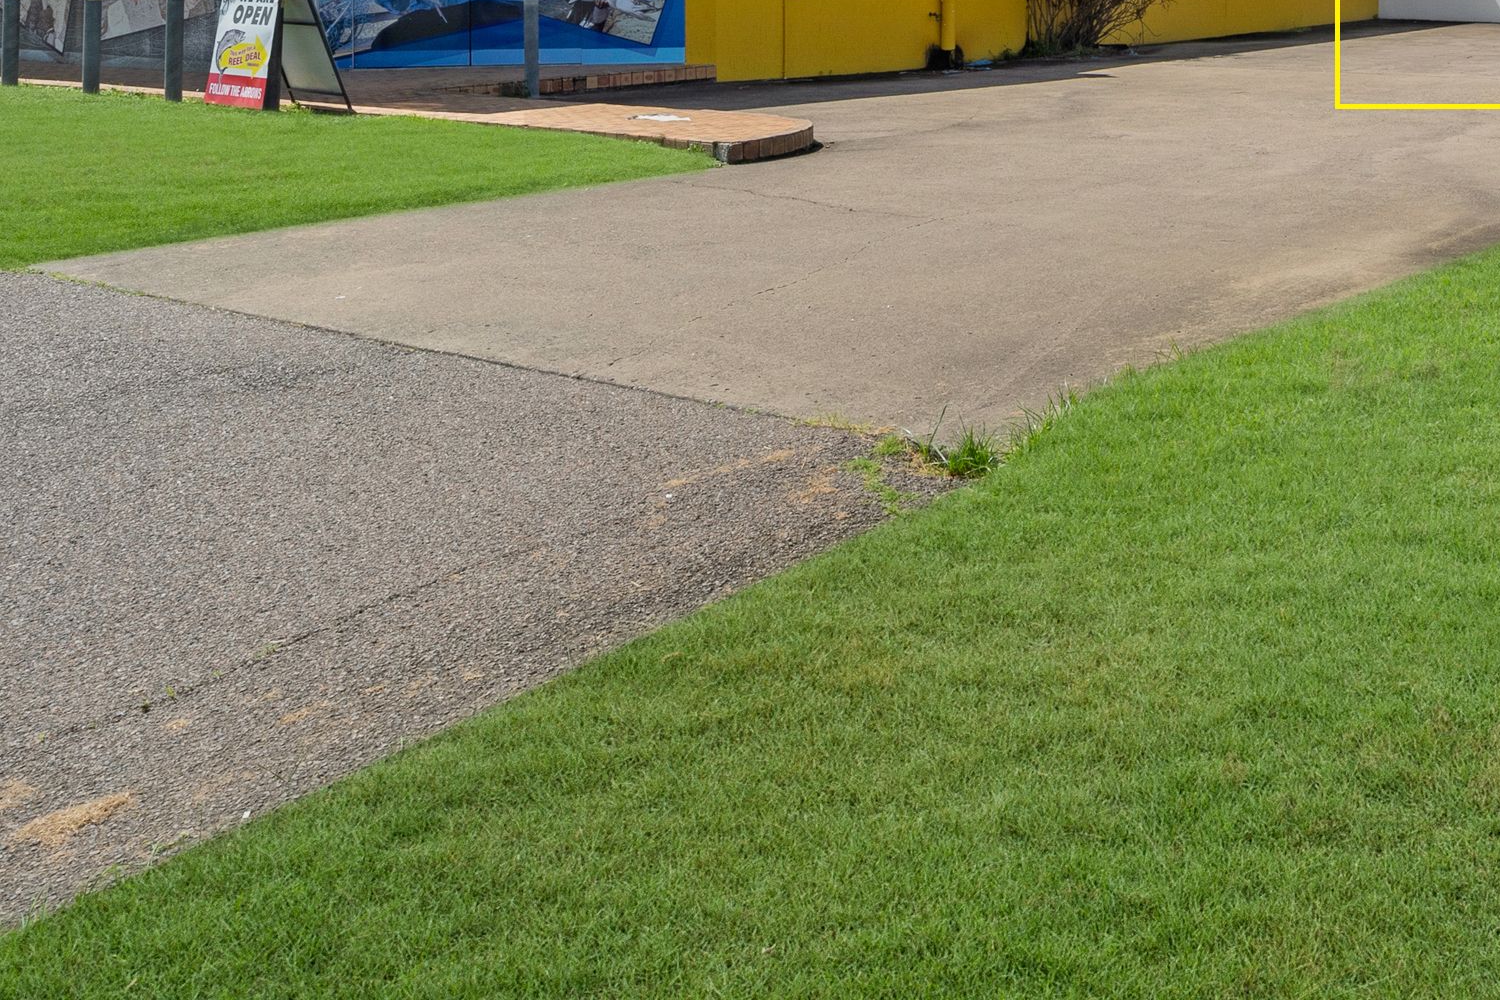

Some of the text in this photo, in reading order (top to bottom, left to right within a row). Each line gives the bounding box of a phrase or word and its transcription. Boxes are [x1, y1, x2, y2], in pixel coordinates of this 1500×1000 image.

[233, 4, 273, 26] OPEN
[228, 56, 243, 65] REEL
[245, 51, 261, 61] DEAL
[208, 82, 262, 100] FOLLOW THE ARROWS
